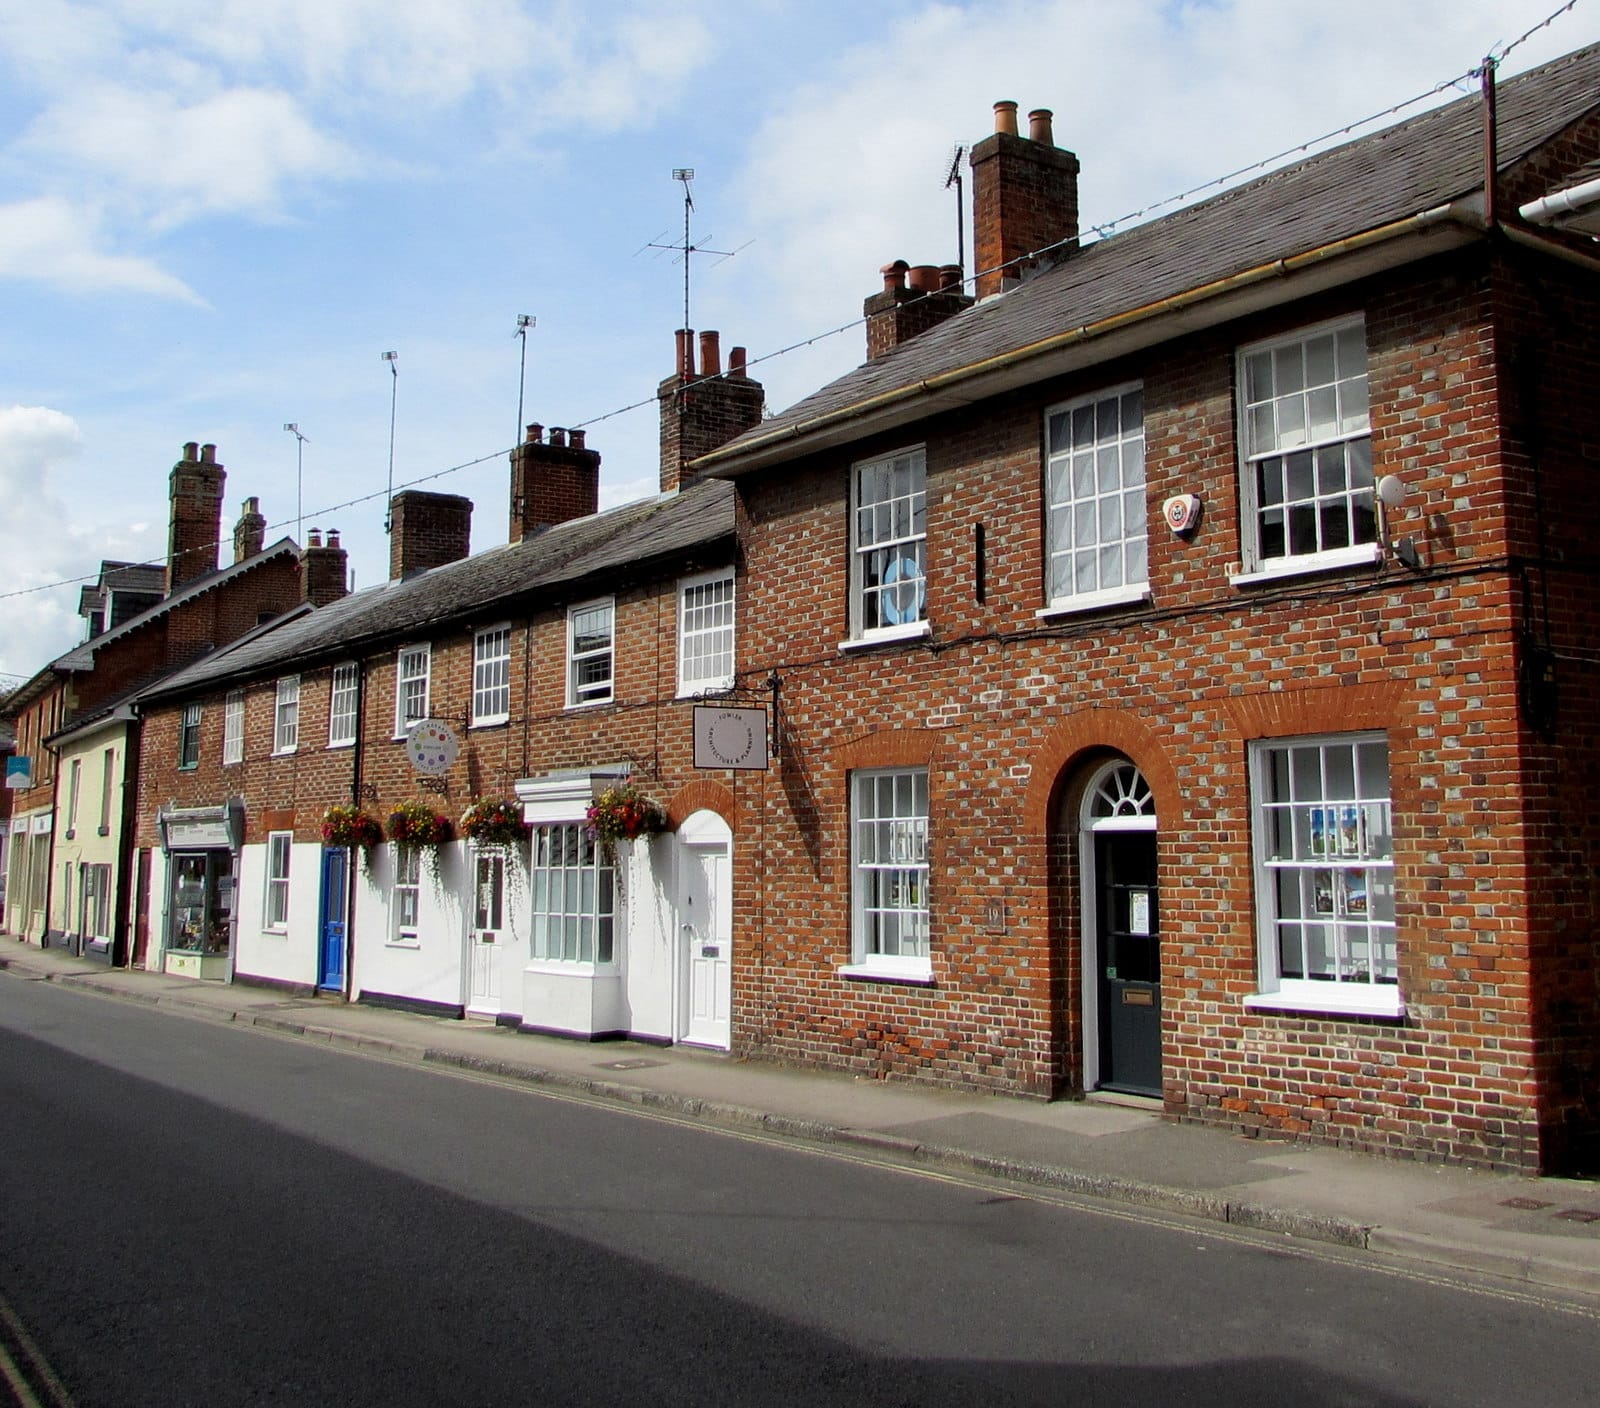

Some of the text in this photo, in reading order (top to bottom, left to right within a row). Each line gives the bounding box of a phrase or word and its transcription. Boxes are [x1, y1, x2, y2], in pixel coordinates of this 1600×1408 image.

[718, 712, 743, 721] FOWLER
[707, 726, 734, 765] ARCHITECTURE
[740, 727, 753, 761] PLANNING
[988, 907, 999, 921] 19
